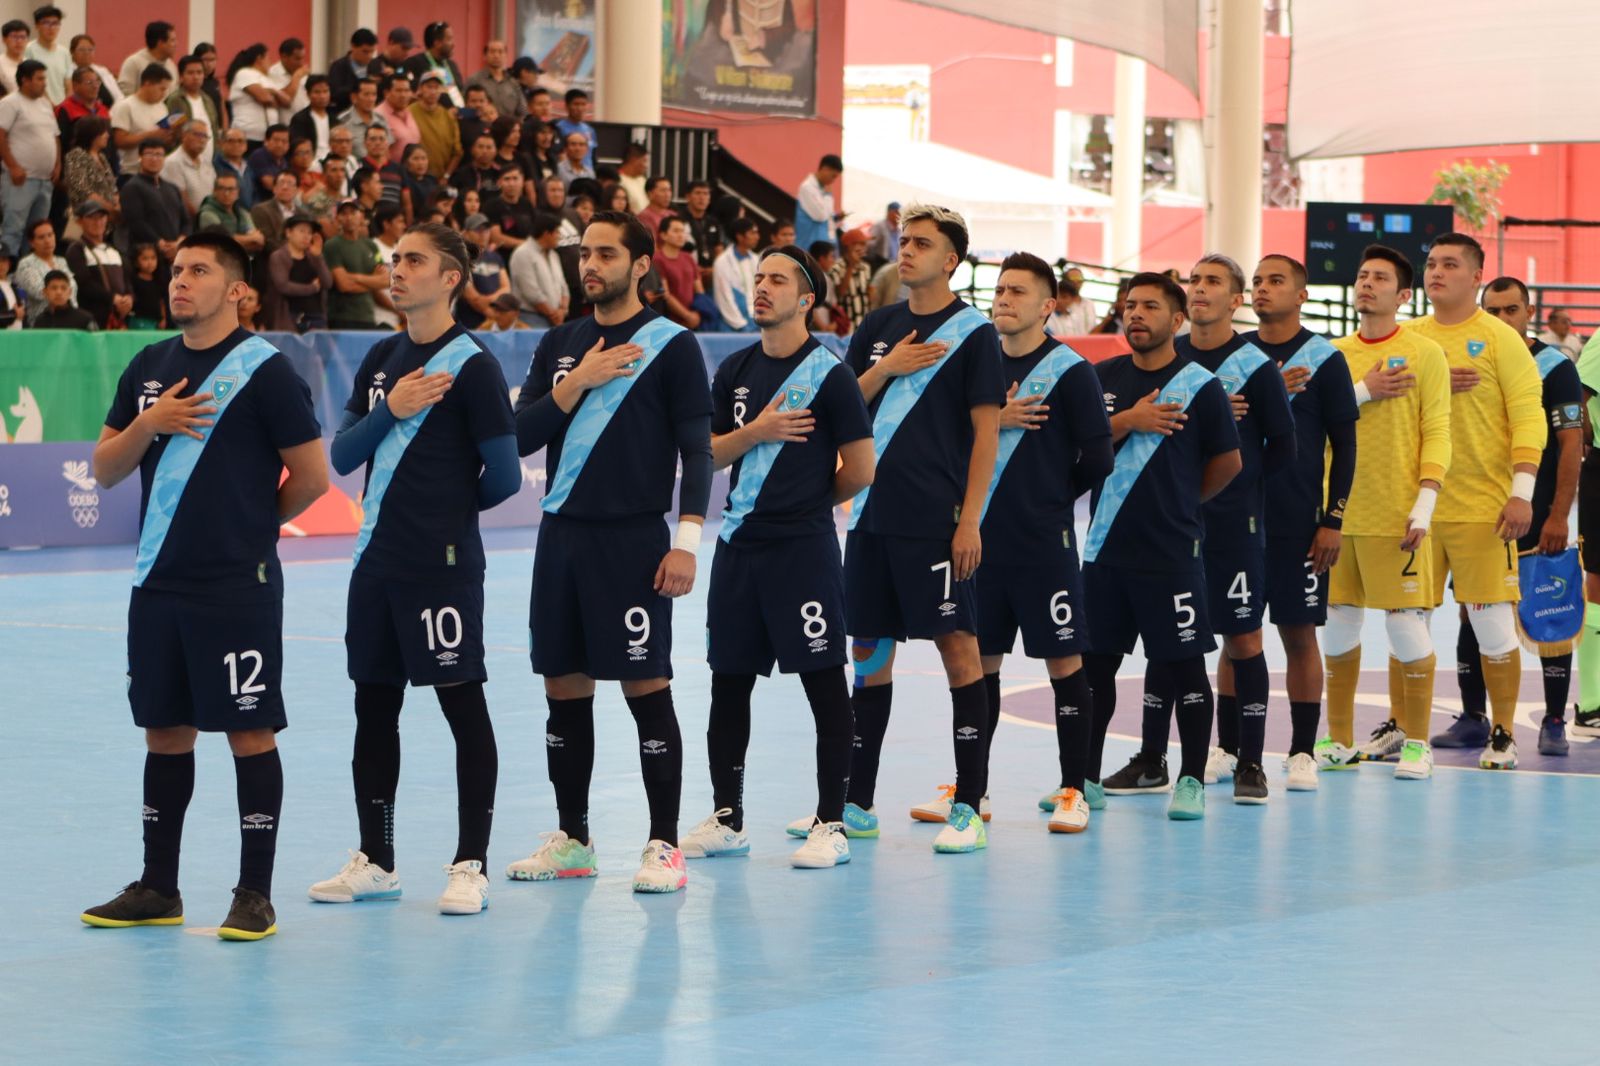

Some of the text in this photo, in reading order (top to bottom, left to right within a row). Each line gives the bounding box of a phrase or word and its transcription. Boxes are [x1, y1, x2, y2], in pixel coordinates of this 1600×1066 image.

[931, 560, 951, 600] 7
[1226, 571, 1252, 605] 4
[1303, 561, 1319, 594] 3
[800, 601, 827, 639] 8
[1049, 590, 1073, 626] 6
[1173, 592, 1196, 629] 5
[421, 606, 463, 651] 10
[624, 606, 650, 647] 9
[439, 659, 458, 668] umbro
[811, 645, 827, 653] umbro
[223, 649, 267, 696] 12
[239, 702, 257, 712] umbro
[643, 746, 667, 755] umbro
[956, 733, 977, 741] umbro
[143, 814, 159, 822] bro
[242, 821, 273, 831] umbro
